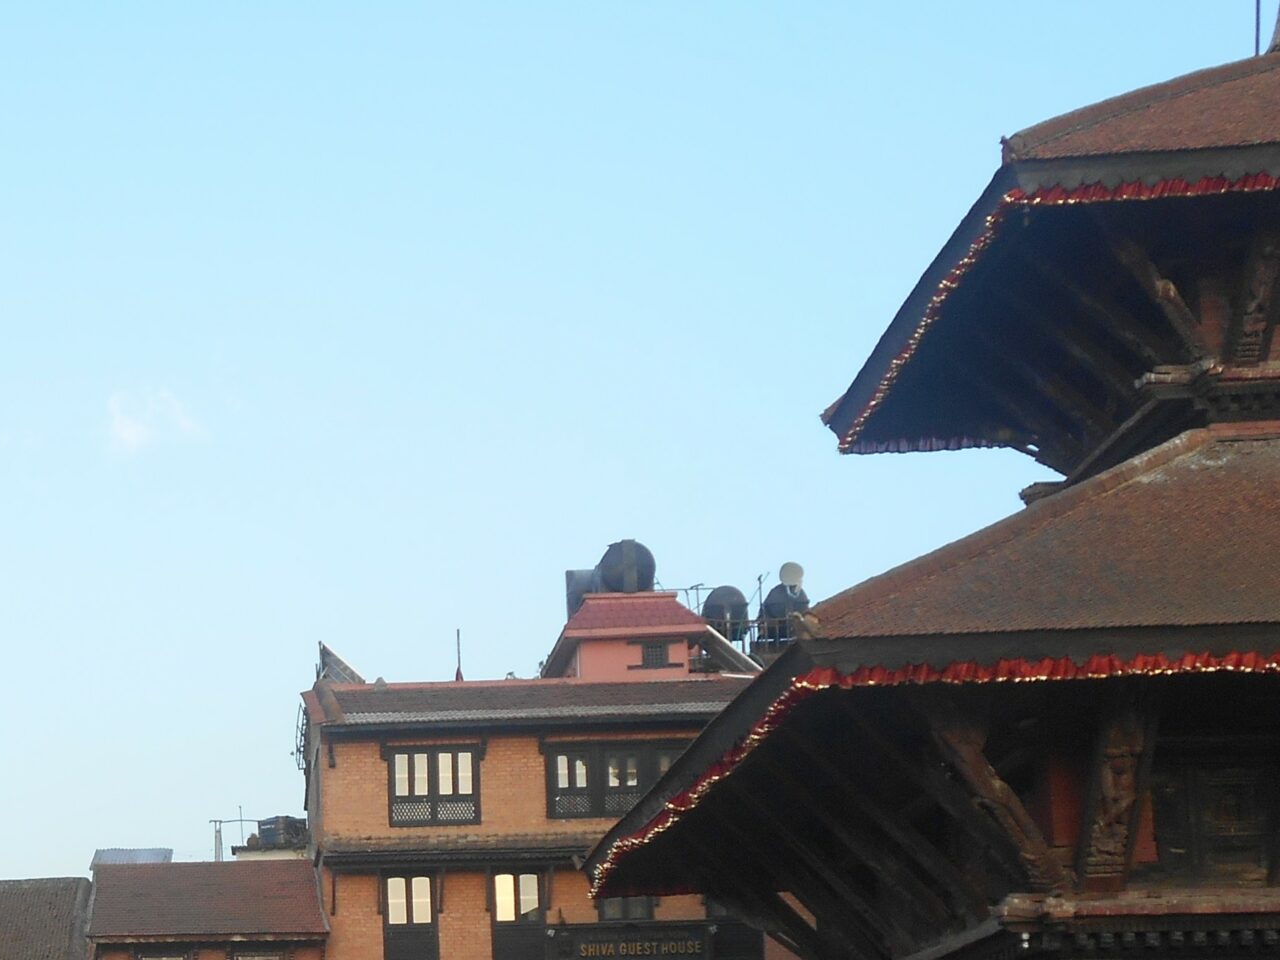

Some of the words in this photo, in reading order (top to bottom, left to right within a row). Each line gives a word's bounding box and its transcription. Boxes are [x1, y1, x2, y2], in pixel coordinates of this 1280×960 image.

[580, 943, 615, 957] SHIVA
[619, 942, 658, 956] GUEST
[661, 940, 702, 954] HOUSE
